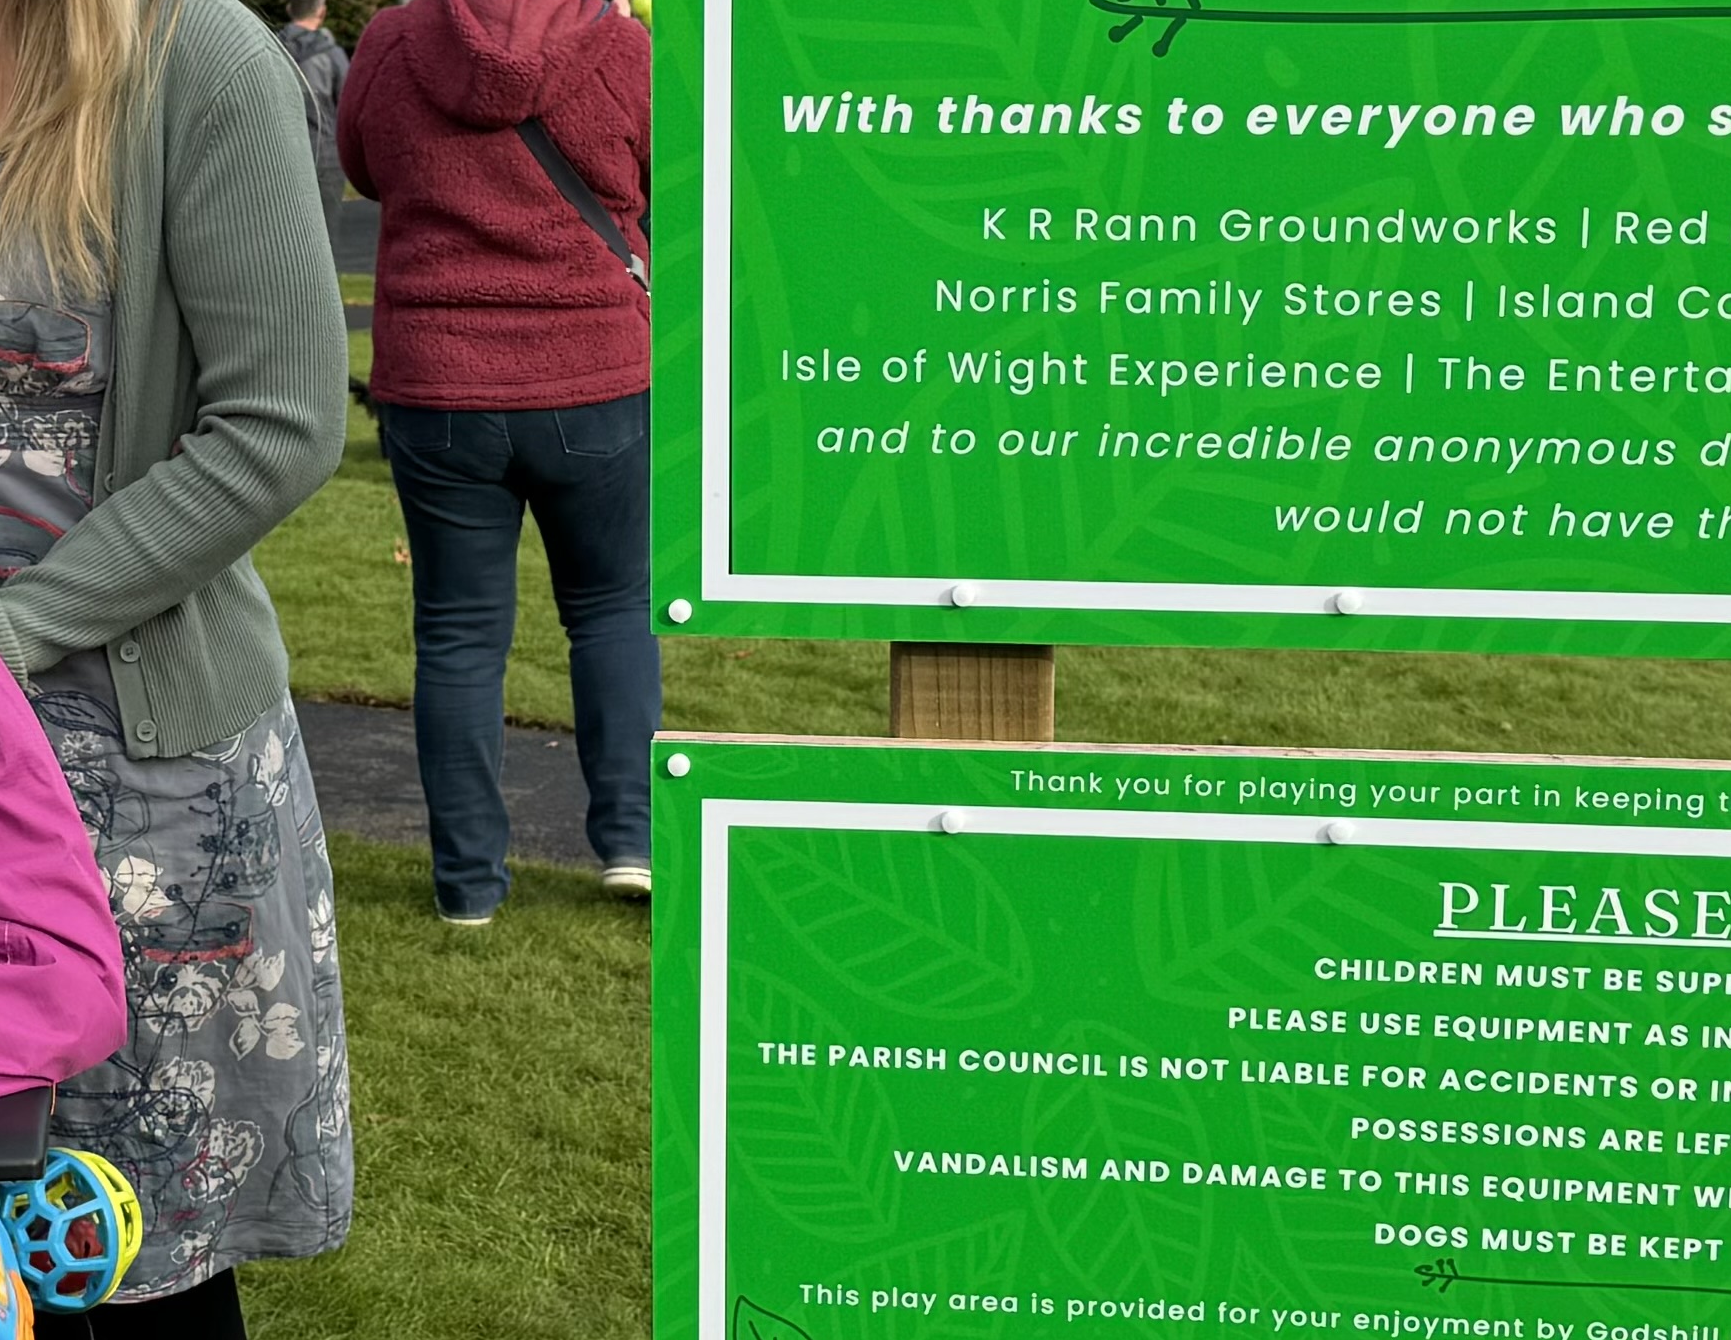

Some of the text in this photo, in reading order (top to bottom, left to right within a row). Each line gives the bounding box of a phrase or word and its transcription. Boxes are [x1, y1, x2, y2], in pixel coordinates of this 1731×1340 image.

[781, 89, 914, 135] With
[936, 93, 1144, 136] thanks
[1166, 96, 1225, 136] to
[1245, 103, 1537, 150] everyone
[1559, 94, 1686, 137] who
[982, 206, 1007, 241] K
[1028, 207, 1053, 242] R
[1074, 207, 1197, 243] Rann
[1218, 207, 1557, 245] Groundworks
[1614, 209, 1709, 246] Red
[935, 277, 1078, 314] Norris
[1099, 279, 1264, 327] Family
[1283, 281, 1442, 318] Stores
[1497, 282, 1655, 320] Island
[781, 347, 862, 383] Isle
[881, 347, 928, 384] of
[946, 348, 1089, 397] Wight
[1108, 352, 1383, 398] Experience
[1437, 355, 1526, 392] The
[816, 419, 911, 455] and
[930, 422, 977, 456] to
[997, 428, 1080, 458] our
[1097, 422, 1353, 462] incredible
[1373, 434, 1677, 475] anonymous
[1313, 956, 1484, 987] CHILDREN
[1495, 963, 1593, 991] MUST
[1602, 967, 1644, 993] BE
[1227, 1006, 1348, 1034] PLEASE
[1359, 1011, 1422, 1037] USE
[1432, 1014, 1634, 1046] EQUIPMENT
[1643, 1022, 1690, 1048] AS
[756, 1041, 818, 1067] THE
[827, 1043, 948, 1072] PARISH
[957, 1048, 1109, 1078] COUNCIL
[1118, 1054, 1150, 1079] IS
[1159, 1056, 1231, 1082] NOT
[1240, 1059, 1351, 1087] LIABLE
[1361, 1063, 1428, 1091] FOR
[1438, 1067, 1639, 1100] ACCIDENTS
[1649, 1076, 1699, 1103] OR
[798, 1282, 860, 1307] This
[870, 1285, 938, 1316] play
[947, 1292, 1019, 1314] area
[1030, 1291, 1056, 1316] is
[1066, 1296, 1206, 1323] provided
[1216, 1300, 1261, 1325] for
[1270, 1308, 1342, 1333] your
[1352, 1309, 1525, 1340] enjoyment
